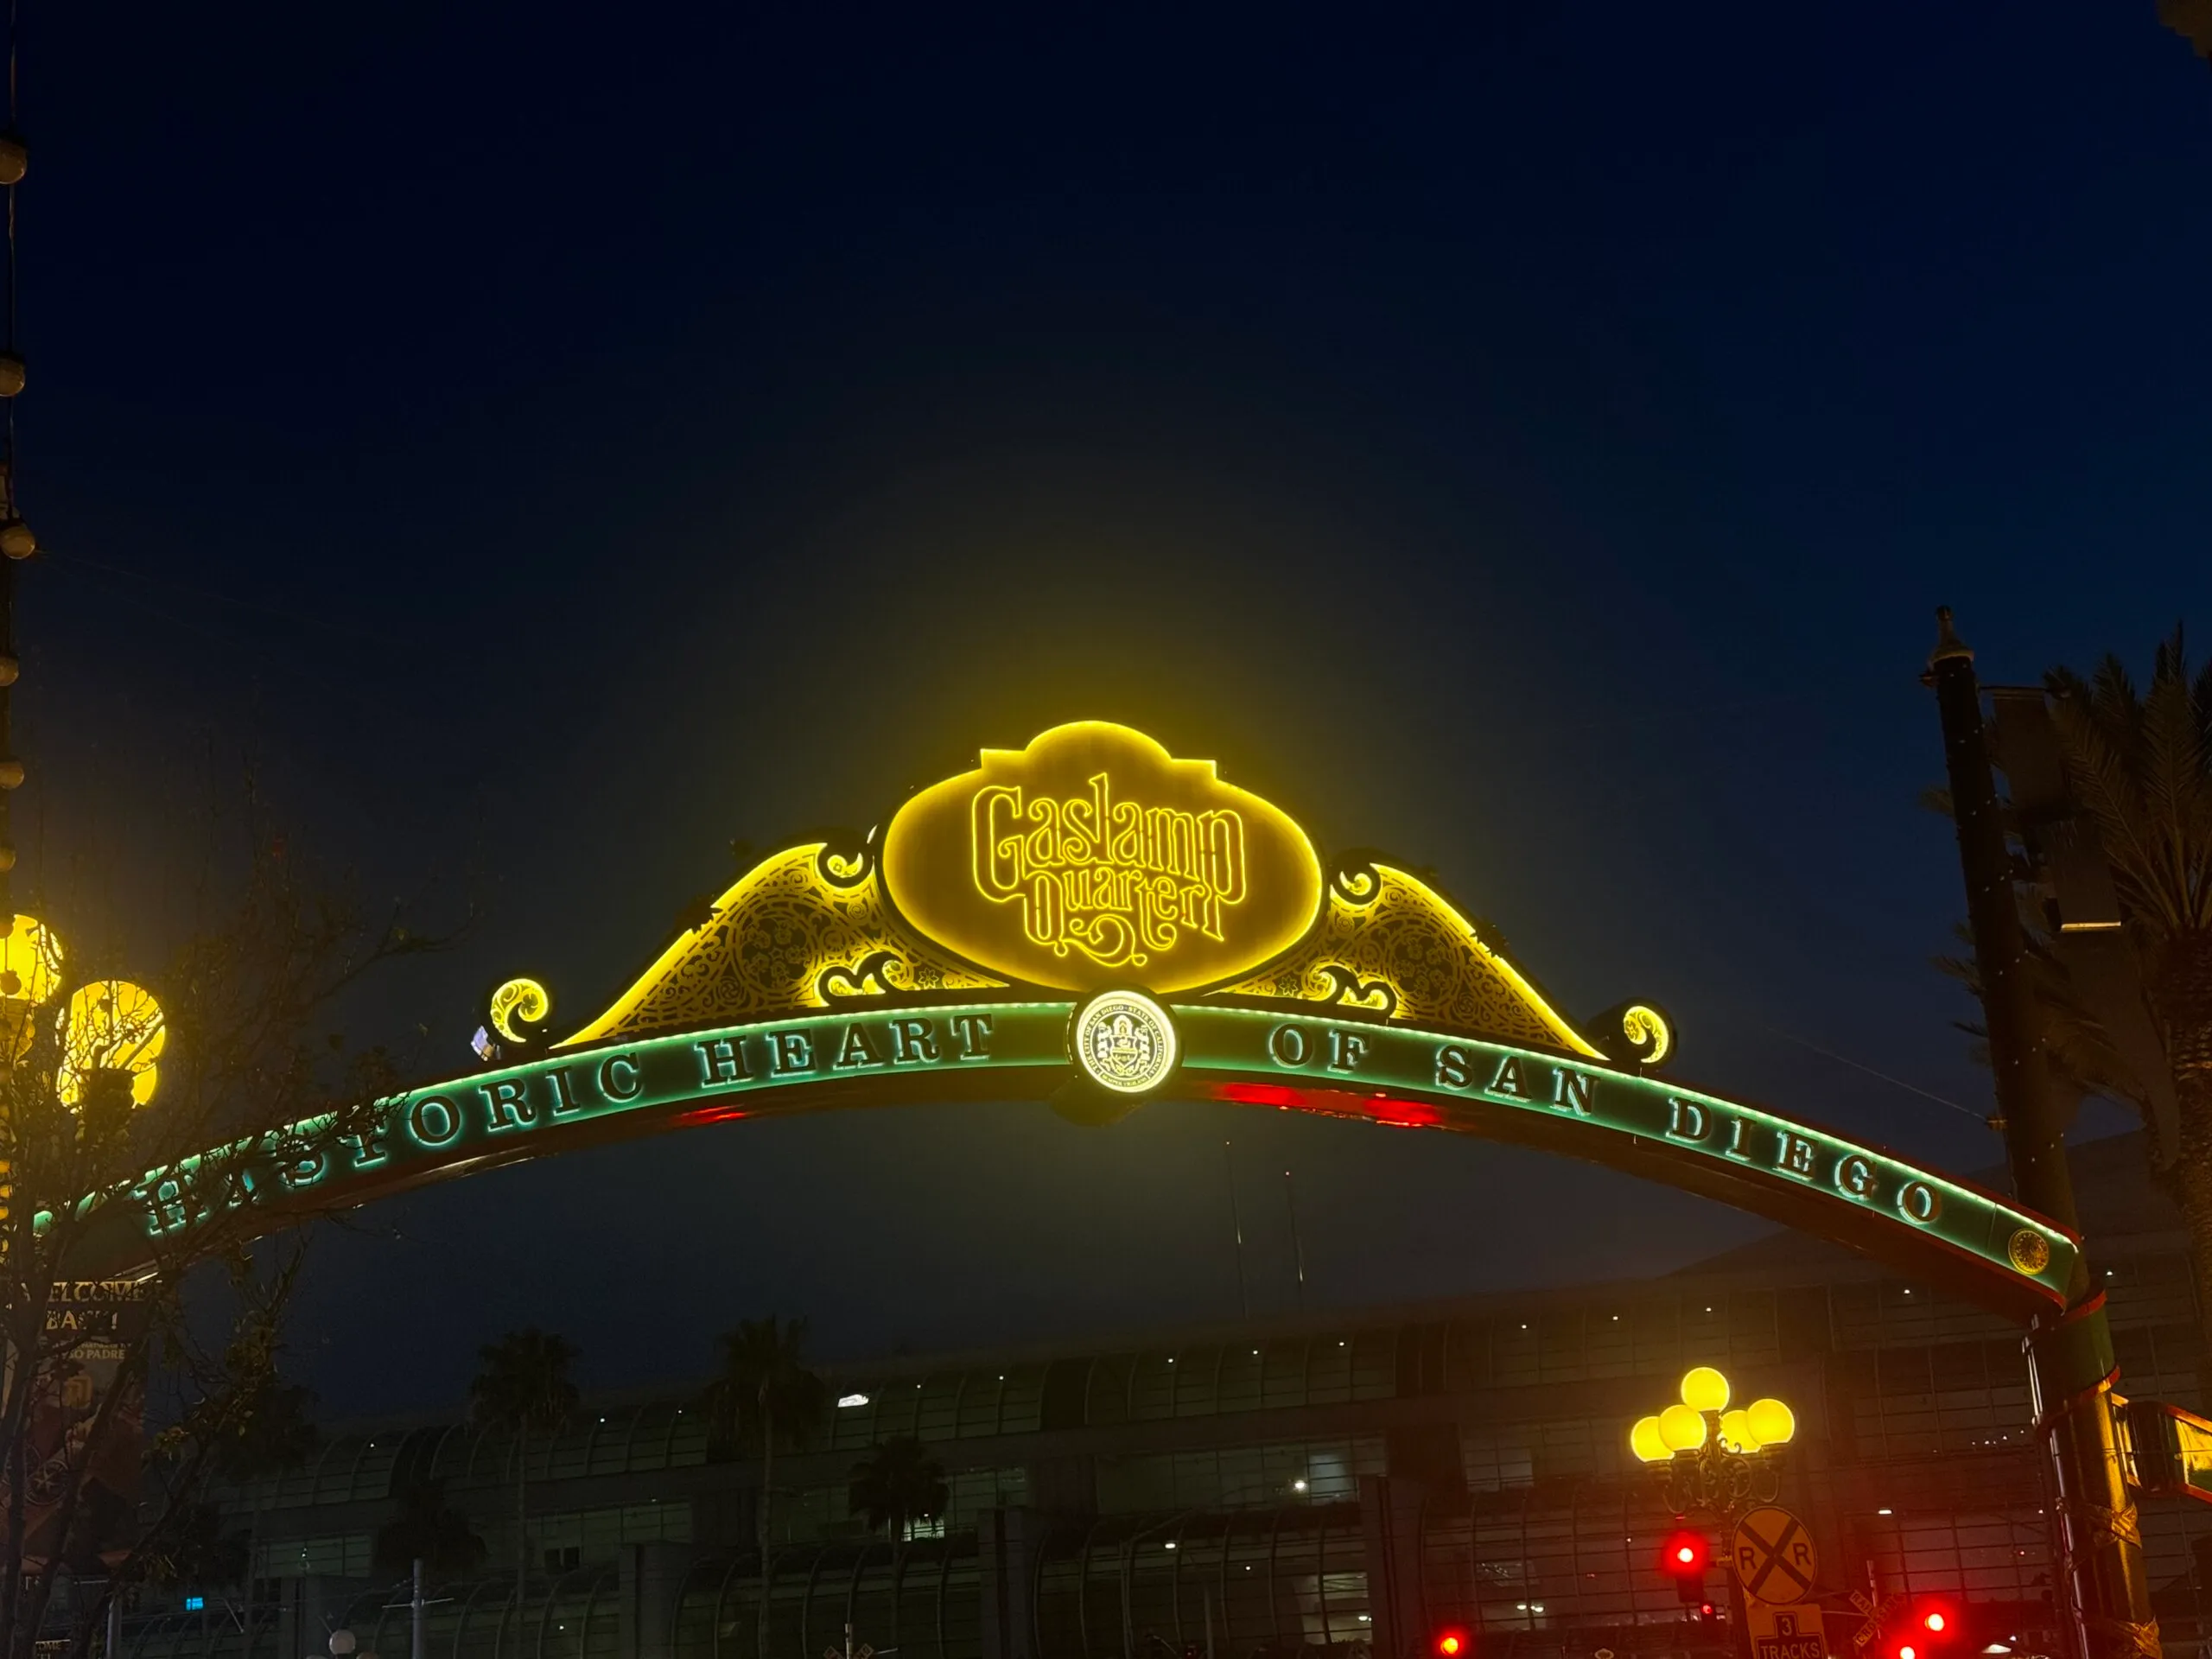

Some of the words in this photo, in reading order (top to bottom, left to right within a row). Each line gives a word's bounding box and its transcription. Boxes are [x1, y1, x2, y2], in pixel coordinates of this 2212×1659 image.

[972, 772, 1247, 905] Gaslamp
[1023, 866, 1225, 967] Quarter
[127, 1052, 644, 1236] HSTORIC
[693, 1013, 997, 1090] HEART
[1268, 1022, 1369, 1075] OF
[1434, 1043, 1601, 1117] SAN
[1665, 1095, 1942, 1225] DIEGO
[86, 1349, 126, 1360] PADRE
[1759, 1641, 1821, 1659] TRACKS
[1780, 1616, 1794, 1637] 3
